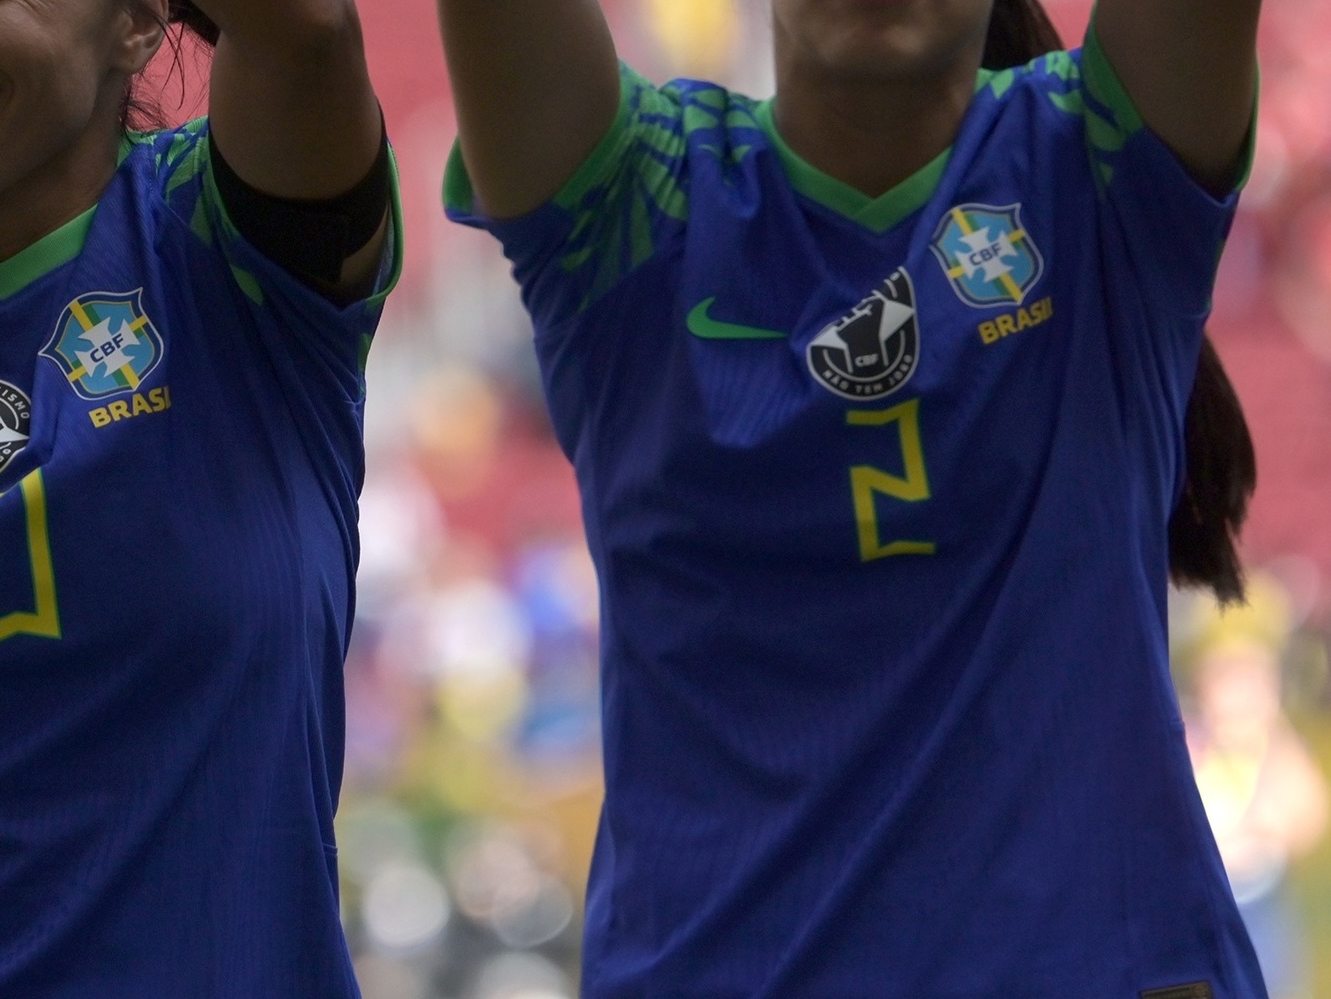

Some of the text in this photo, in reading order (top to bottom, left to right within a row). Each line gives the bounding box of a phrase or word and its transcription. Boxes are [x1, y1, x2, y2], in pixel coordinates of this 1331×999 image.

[969, 243, 1001, 266] CBF
[90, 333, 124, 363] CBF
[846, 398, 937, 564] 2
